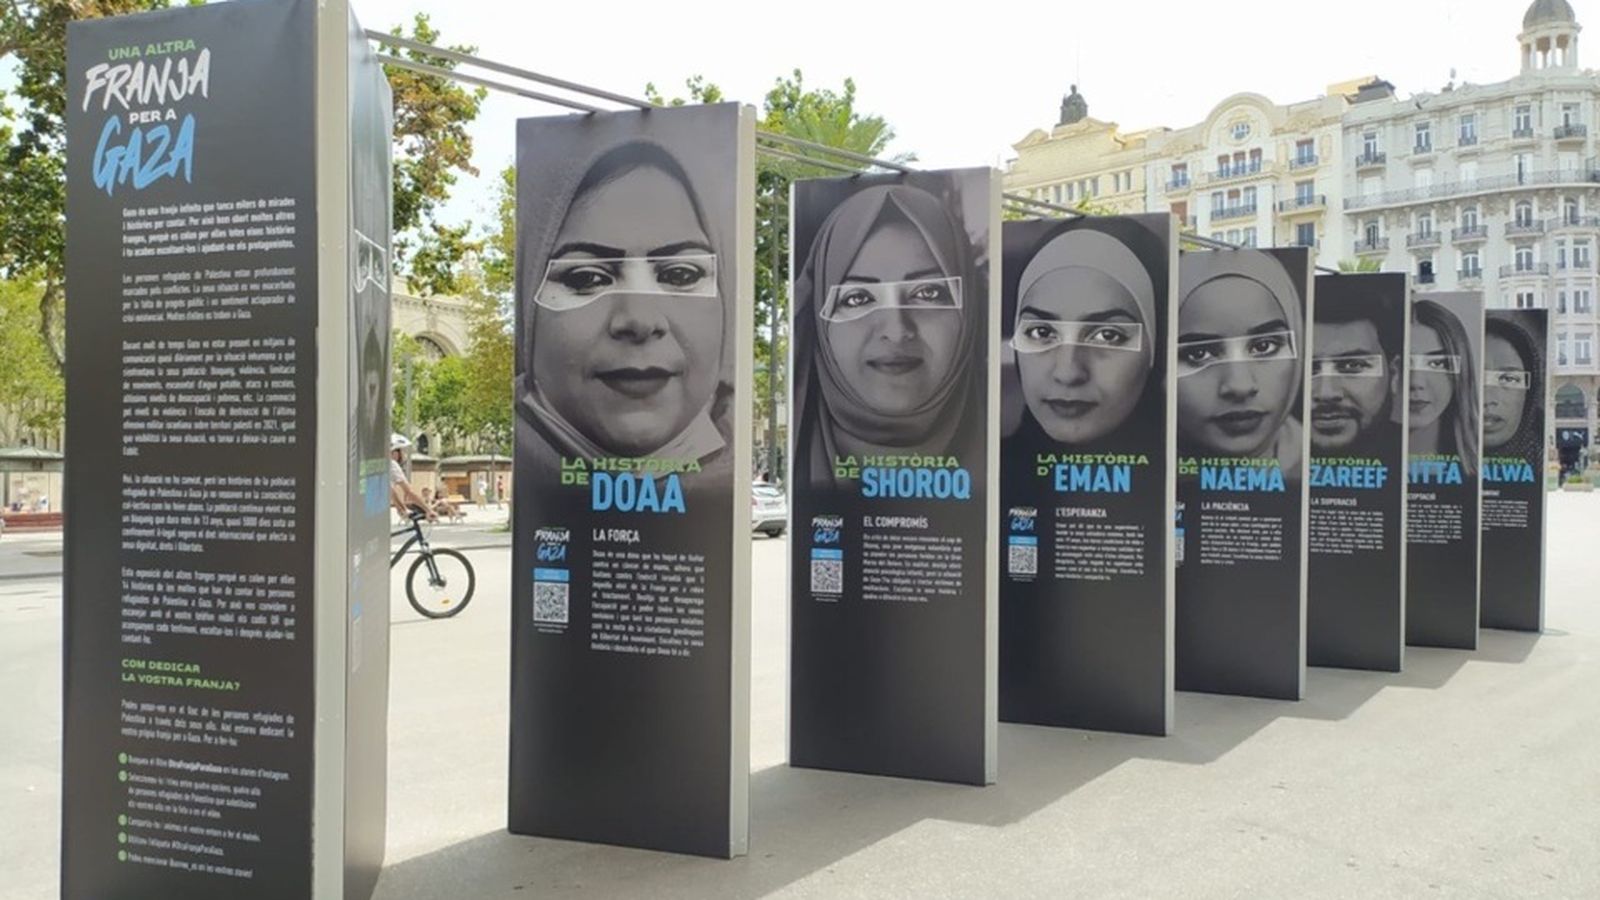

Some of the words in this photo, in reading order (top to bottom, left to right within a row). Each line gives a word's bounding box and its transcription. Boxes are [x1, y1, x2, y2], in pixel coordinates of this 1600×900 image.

[108, 48, 141, 60] UNA
[145, 39, 196, 55] ALTRA
[82, 48, 211, 112] FRANJA
[130, 110, 162, 124] PER
[165, 108, 177, 120] A
[92, 113, 196, 197] GAZA
[562, 457, 586, 470] LA
[835, 456, 858, 466] LA
[863, 453, 960, 468] HISTÒRIA
[1037, 454, 1057, 463] LA
[1062, 452, 1149, 464] HISTÒRIA
[1202, 456, 1280, 466] HISTÒRIA
[1179, 466, 1198, 474] DE
[1201, 466, 1286, 492] NAEMA
[1310, 465, 1388, 488] ZAREEF
[1408, 462, 1462, 484] ITTA
[834, 468, 860, 478] DE
[862, 468, 970, 499] SHOROQ
[562, 472, 589, 484] DE
[592, 472, 686, 513] DOAA
[1202, 502, 1210, 510] LA
[863, 516, 874, 528] EL
[875, 514, 928, 529] COMPROMÍS
[592, 528, 606, 542] LA
[608, 528, 640, 545] FORÇA
[536, 542, 566, 561] GAZA
[122, 658, 146, 669] COM
[149, 660, 200, 674] DEDICAR
[122, 674, 136, 682] LA
[138, 674, 183, 686] VOSTRA
[186, 678, 240, 690] FRANJA?
